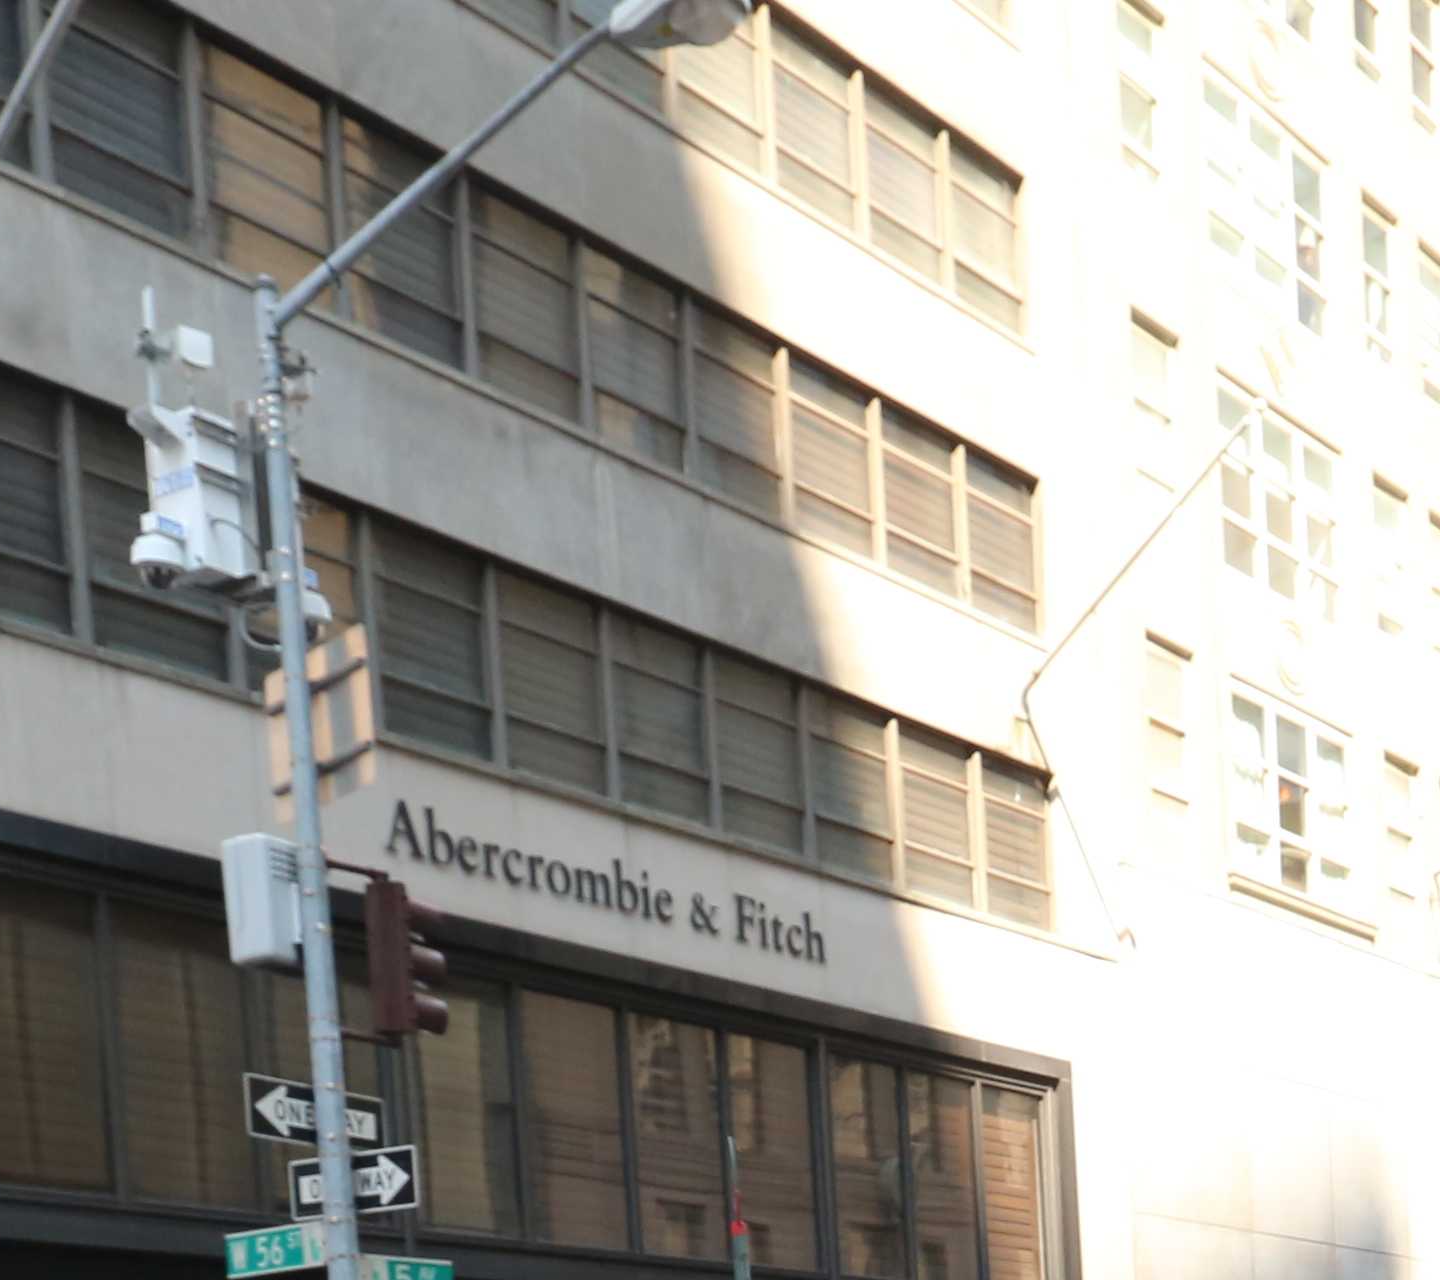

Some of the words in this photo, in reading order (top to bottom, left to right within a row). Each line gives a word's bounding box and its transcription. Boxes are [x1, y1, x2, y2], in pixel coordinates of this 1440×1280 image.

[386, 799, 674, 924] Abercrombie
[689, 892, 720, 937] &
[732, 892, 828, 966] Fitch
[273, 1099, 317, 1125] ONE
[228, 1239, 248, 1272] W
[254, 1234, 286, 1269] 56
[286, 1229, 303, 1250] ST
